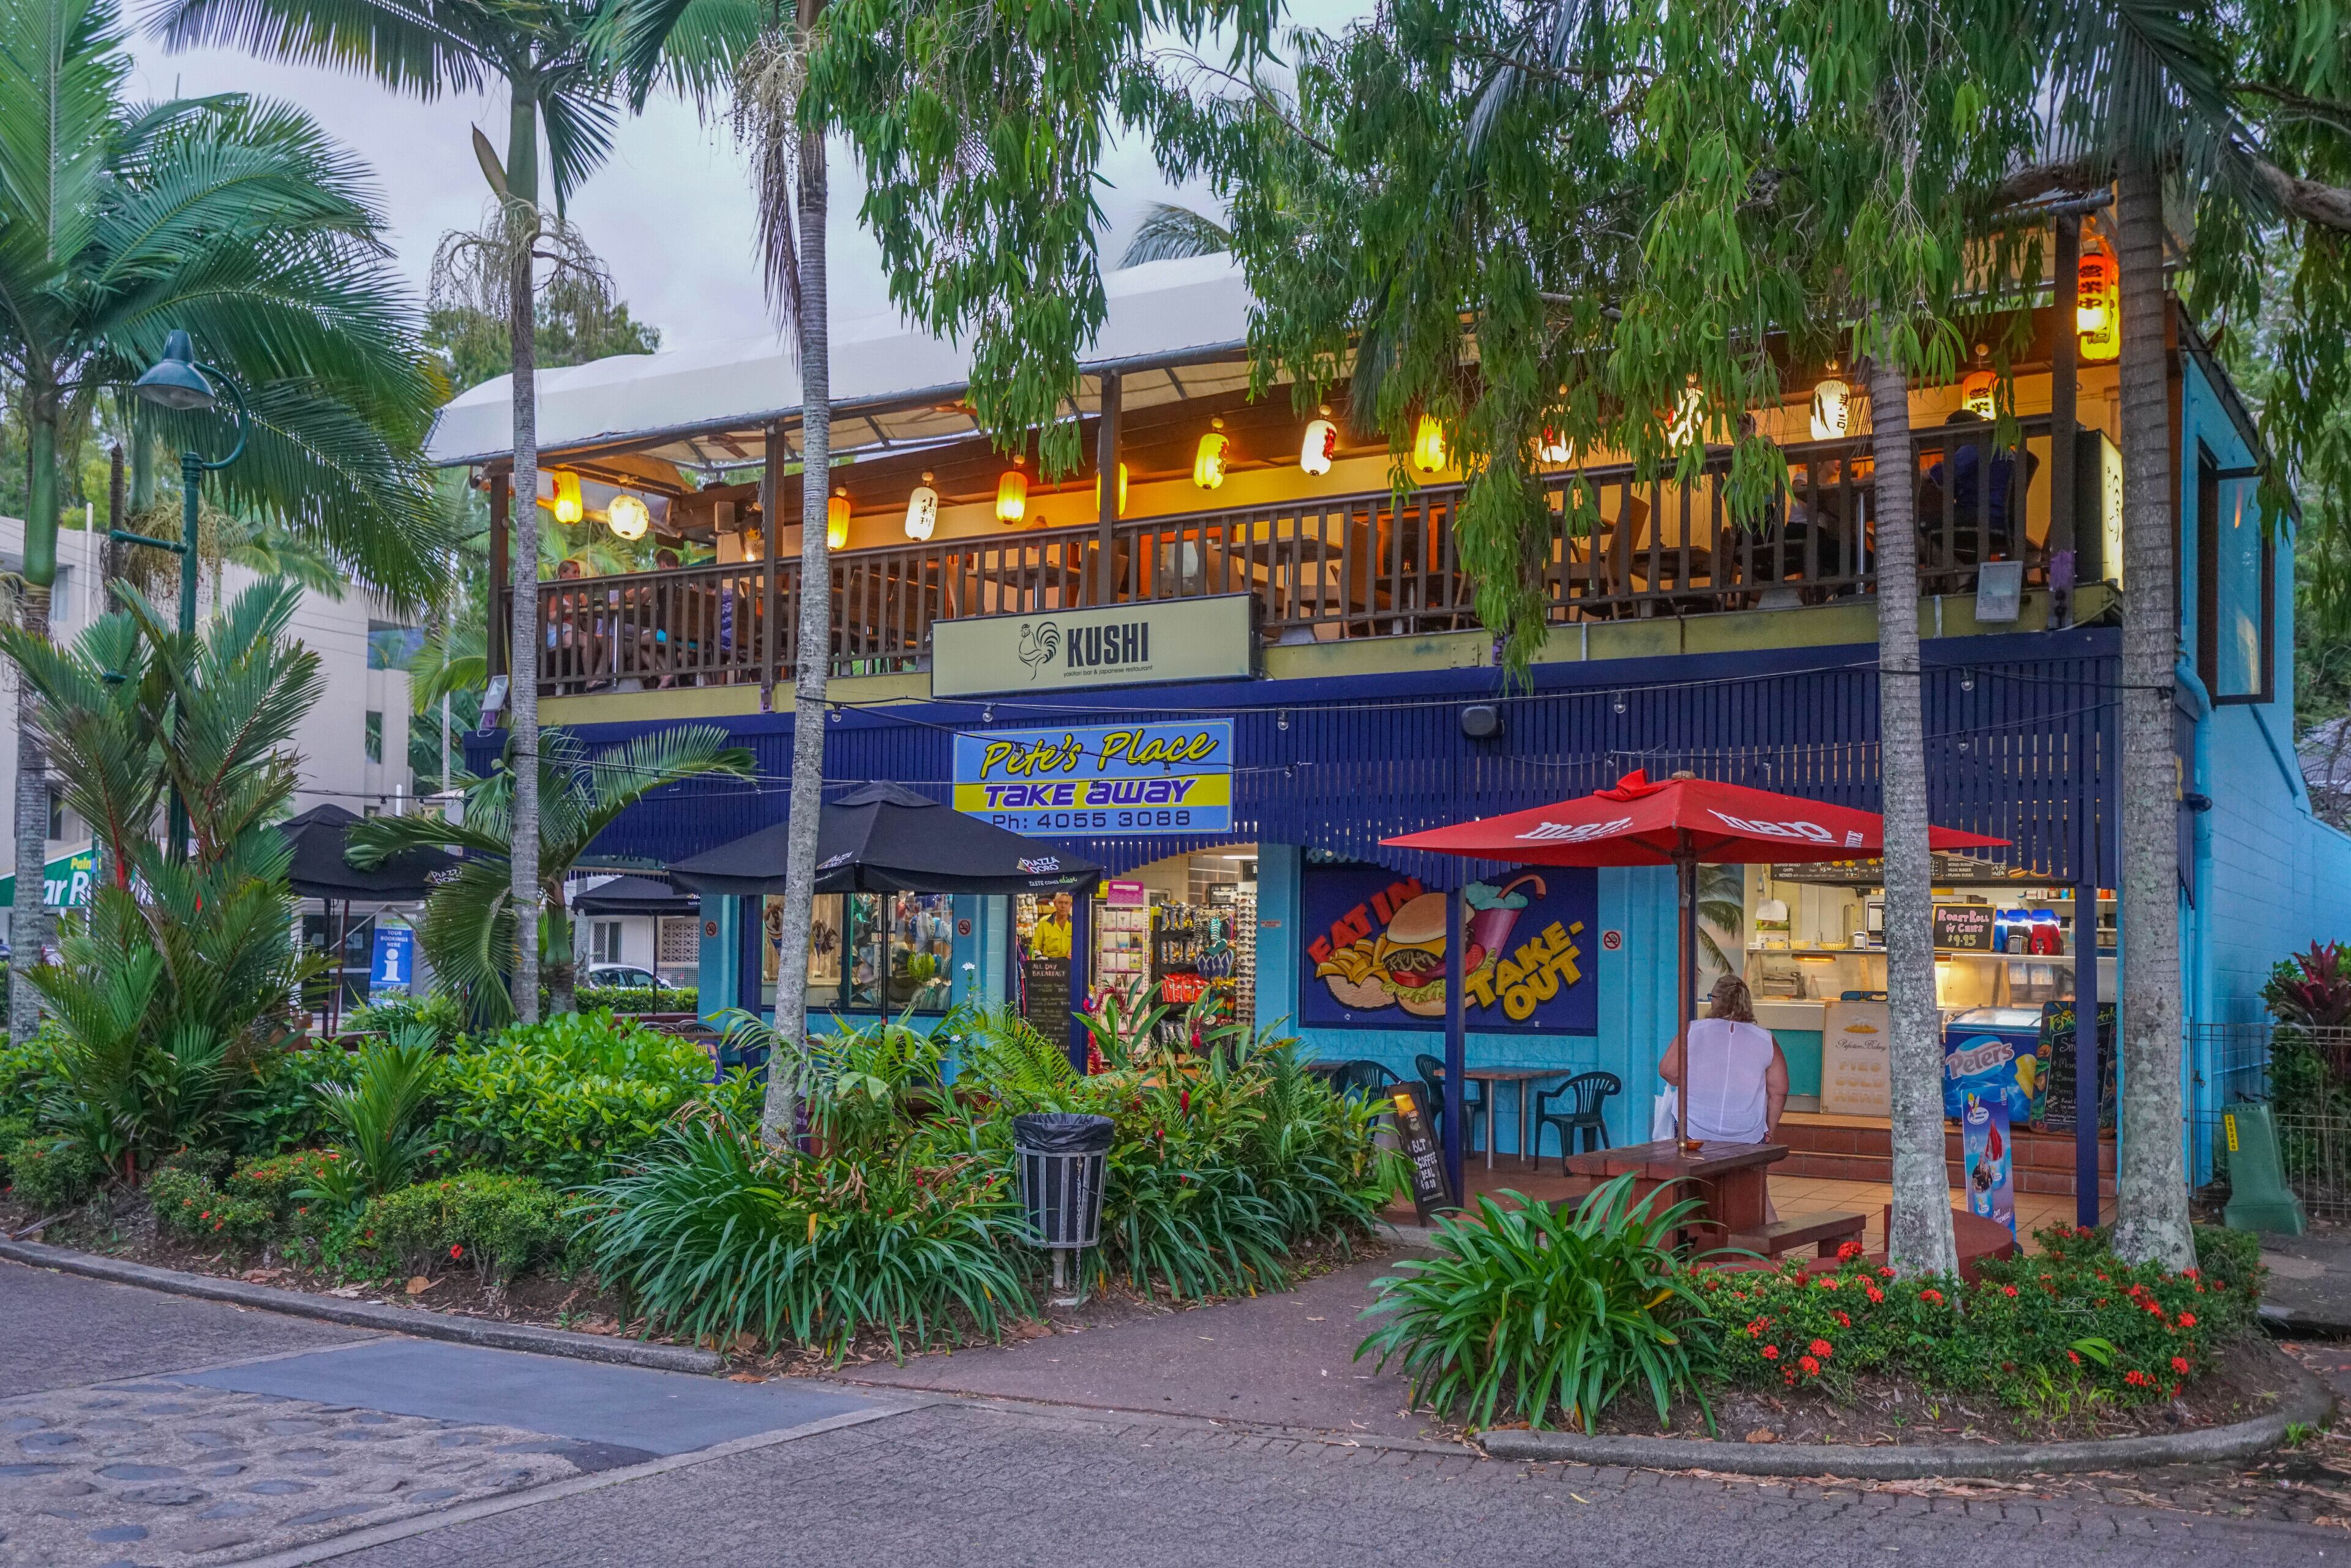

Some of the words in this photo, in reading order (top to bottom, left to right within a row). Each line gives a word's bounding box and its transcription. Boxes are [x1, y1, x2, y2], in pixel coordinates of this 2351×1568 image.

[1067, 621, 1149, 668] KUSHI
[980, 733, 1083, 780] Pete's
[1097, 728, 1220, 772] Place
[992, 814, 1028, 829] Ph:
[1037, 812, 1107, 828] 4055
[1118, 810, 1190, 827] 3088
[1021, 857, 1060, 868] PIAZZA
[1307, 903, 1372, 964] EAT
[1948, 934, 1976, 947] $9.95
[1503, 945, 1584, 1021] OUT
[1945, 1043, 2015, 1079] Peters
[1411, 1138, 1426, 1153] BLT
[1421, 1167, 1435, 1180] DEAL
